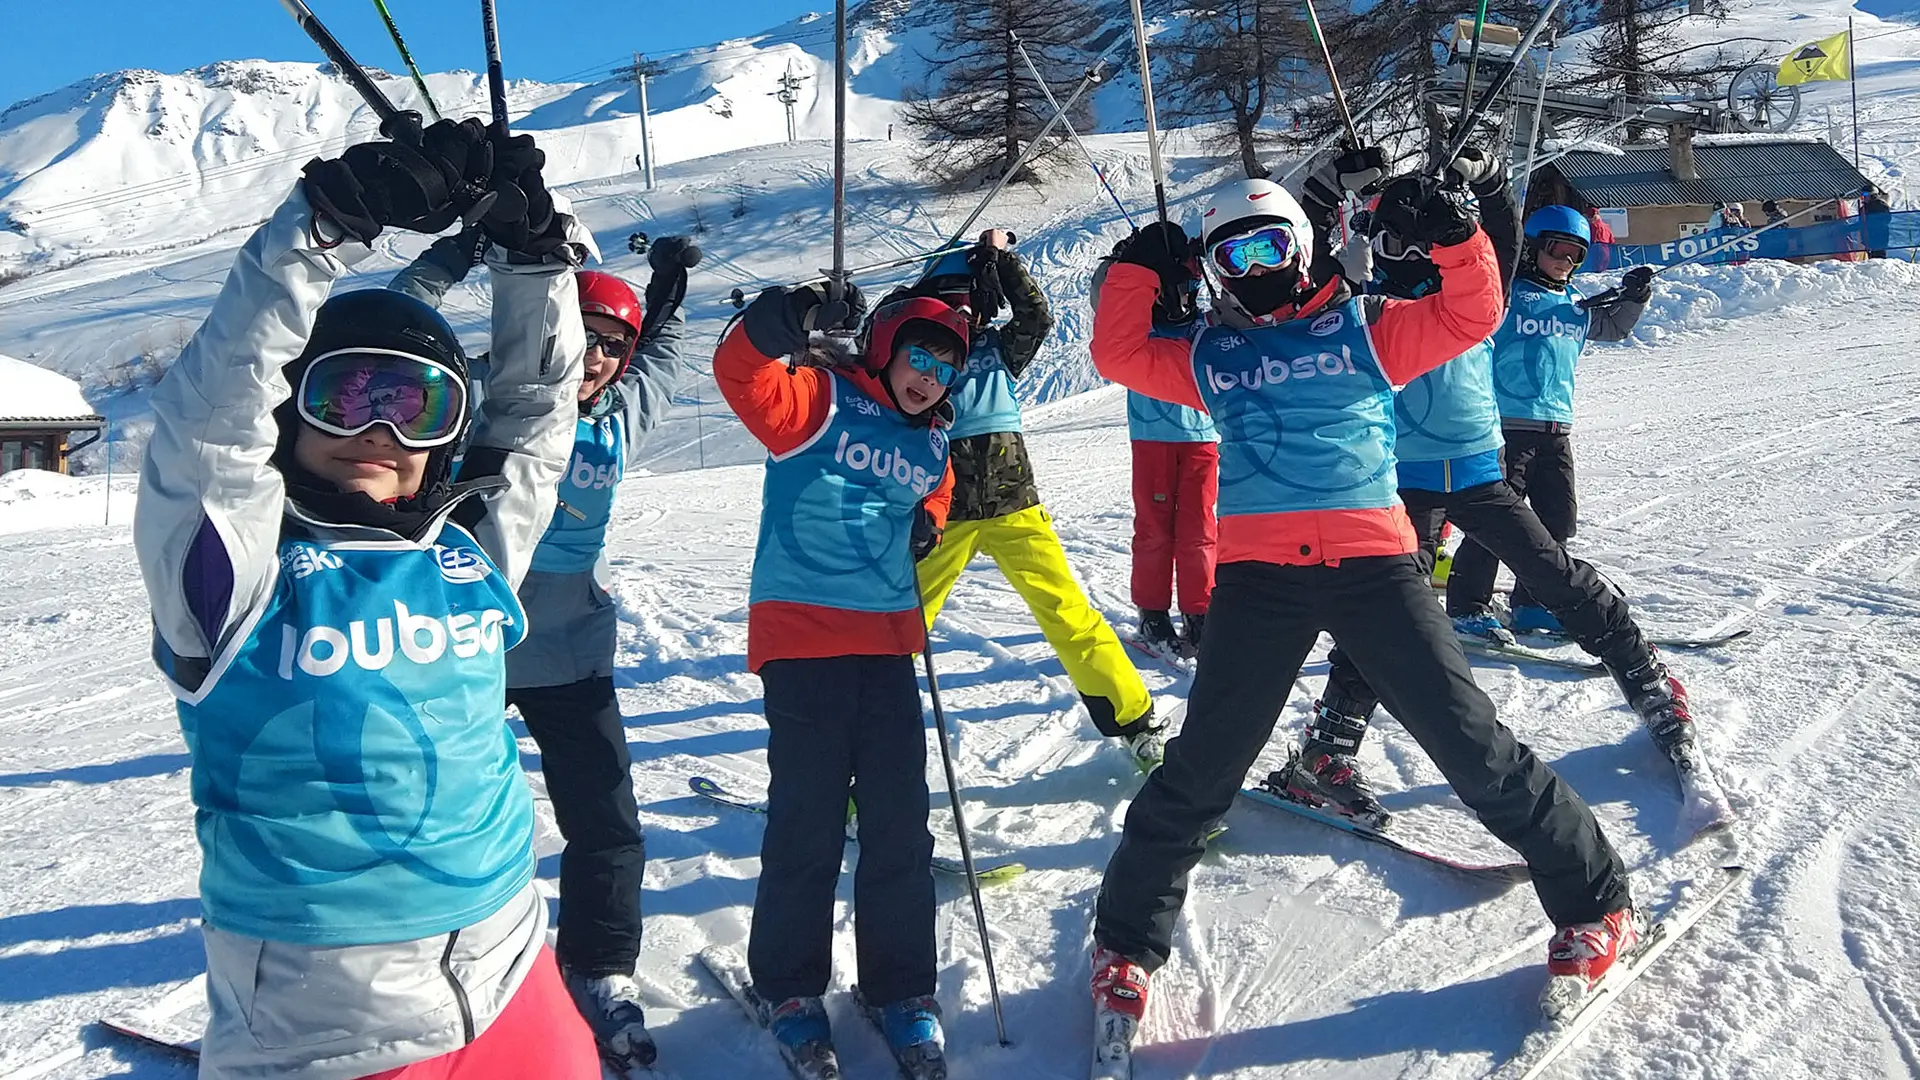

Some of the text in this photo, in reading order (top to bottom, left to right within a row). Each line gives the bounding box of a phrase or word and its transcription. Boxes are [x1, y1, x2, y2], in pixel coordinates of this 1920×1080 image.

[1661, 234, 1760, 261] FOURS
[1516, 313, 1586, 342] loubsol
[1205, 344, 1357, 395] loubsol
[857, 400, 881, 417] SKI
